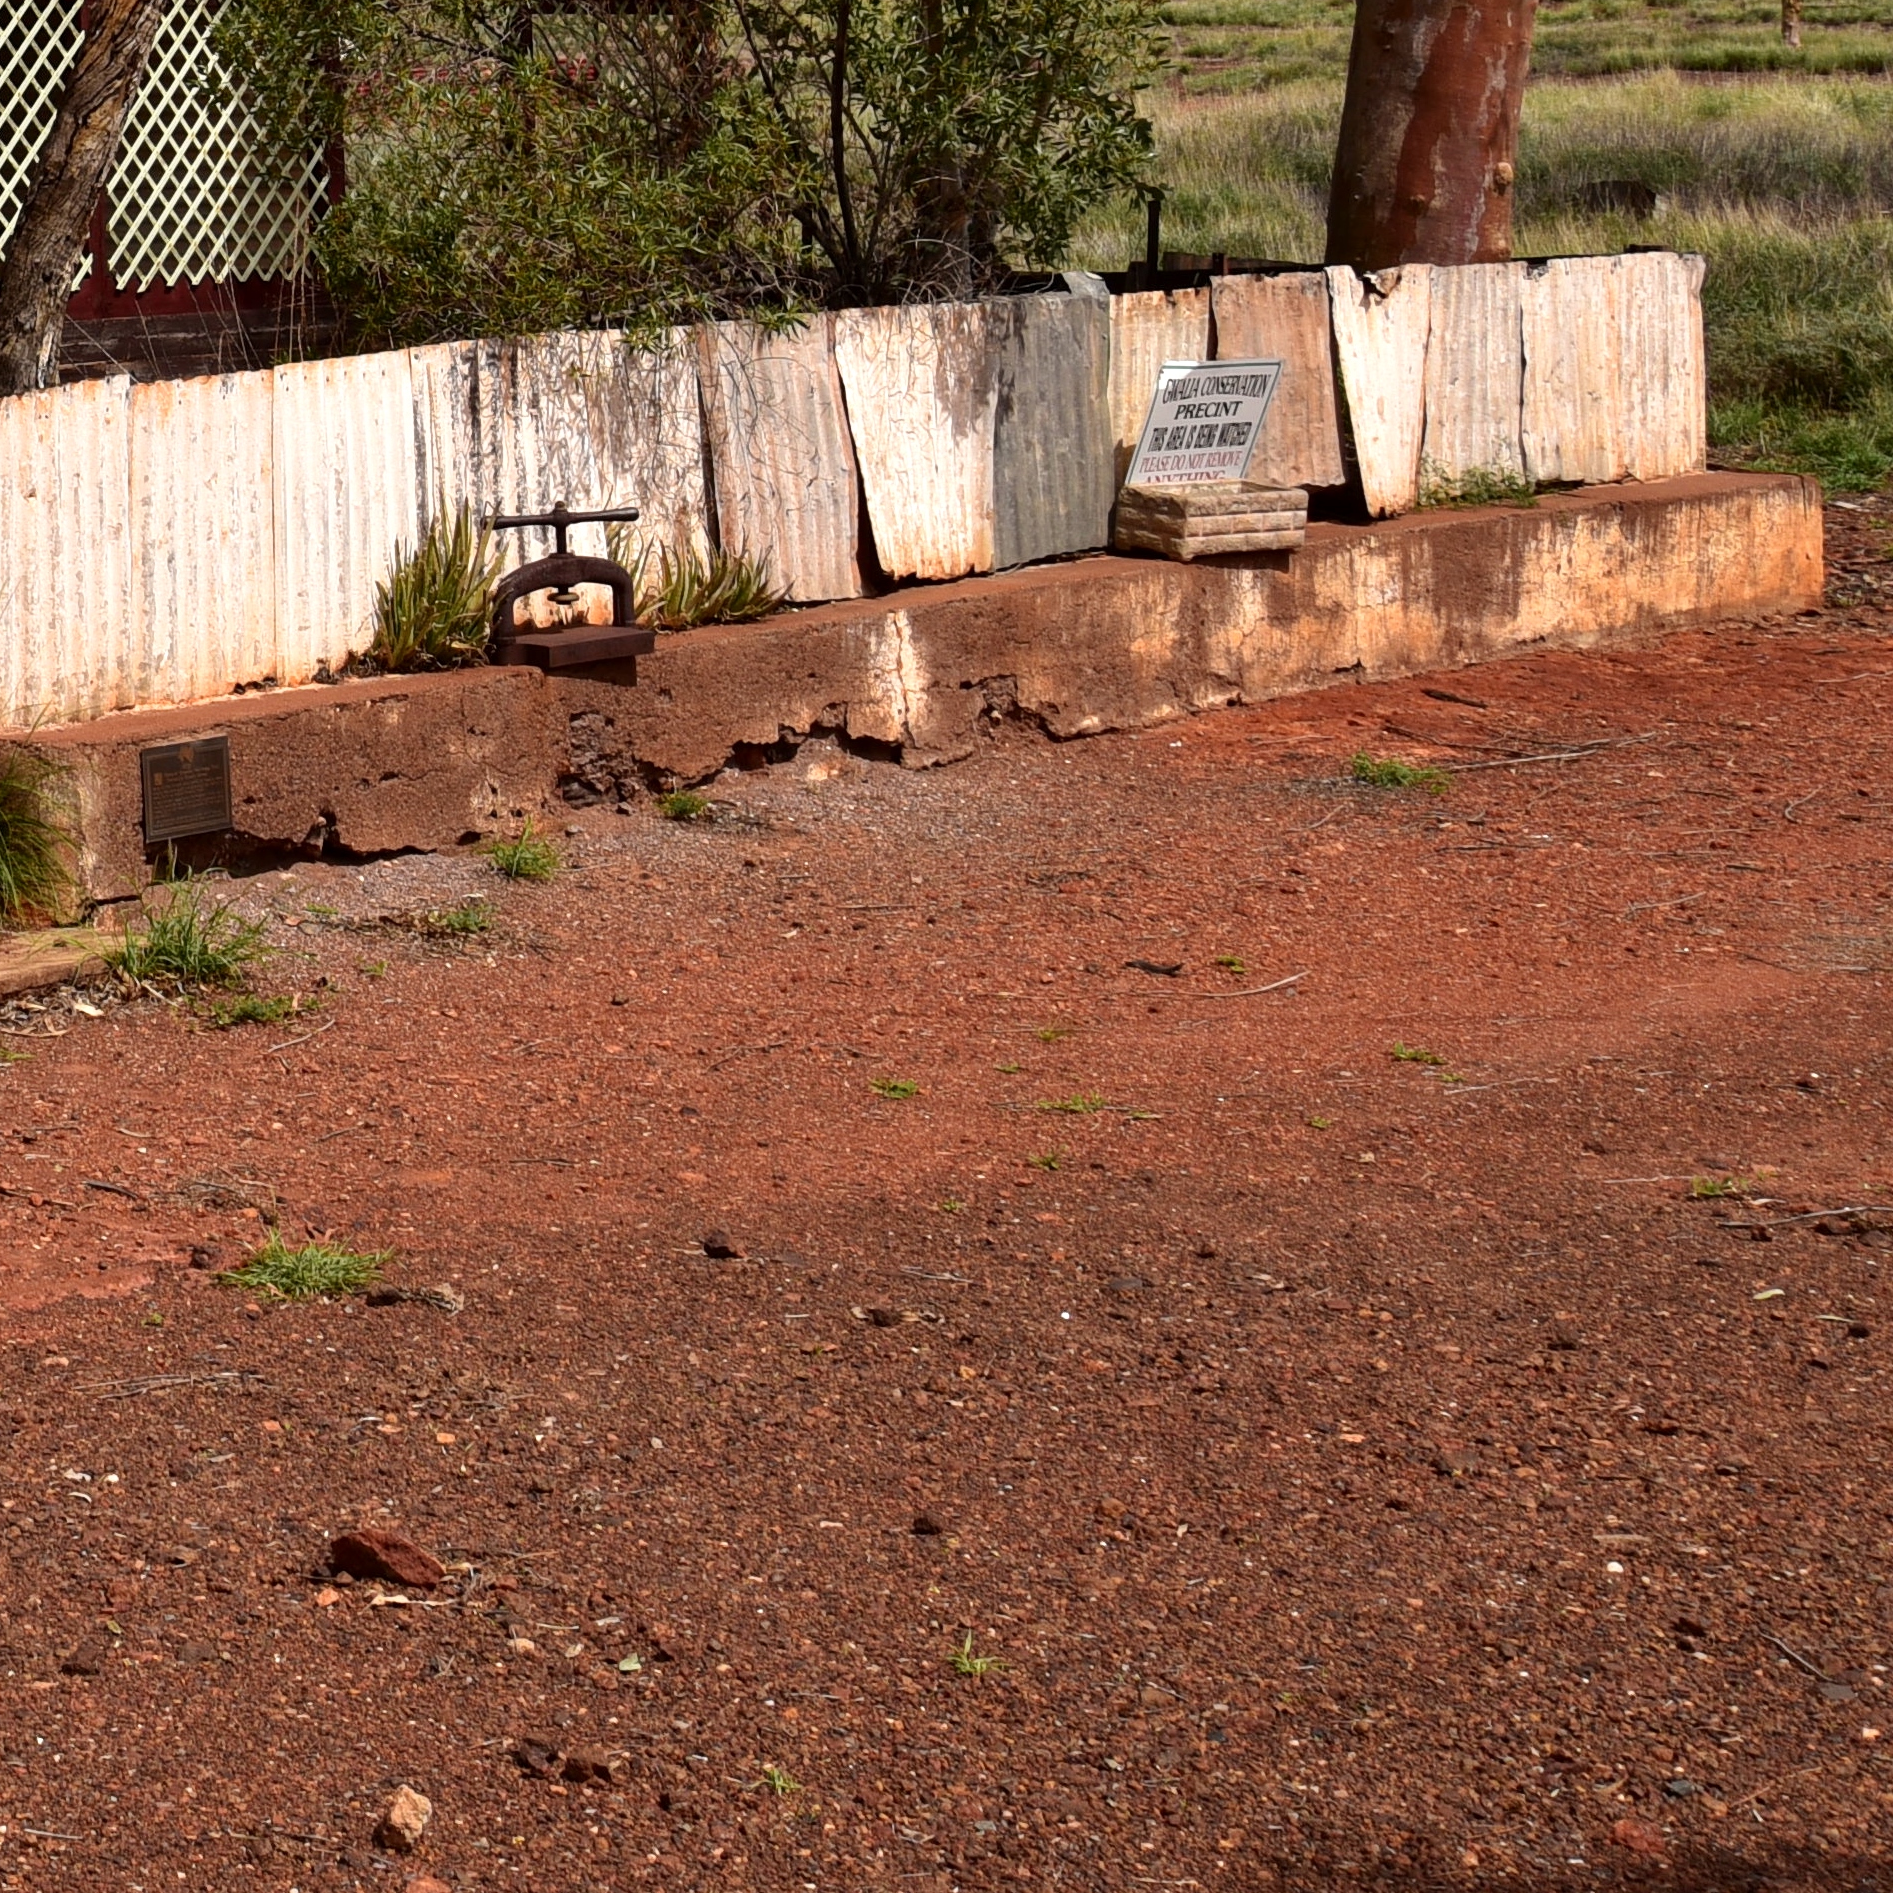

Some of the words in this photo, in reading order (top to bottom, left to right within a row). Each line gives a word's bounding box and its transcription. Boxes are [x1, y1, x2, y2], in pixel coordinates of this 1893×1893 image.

[1162, 378, 1200, 404] GWALIA
[1200, 374, 1271, 398] CONSERVATION
[1174, 401, 1243, 420] PRECINT
[1147, 427, 1168, 452] THIS
[1163, 425, 1187, 451] AREA
[1184, 425, 1197, 449] IS
[1193, 423, 1219, 449] BEING
[1216, 422, 1252, 447] WATCHED
[1139, 456, 1171, 473] PLEASE
[1170, 454, 1187, 470] DO
[1185, 453, 1207, 469] NOT
[1203, 451, 1243, 467] REMOVE
